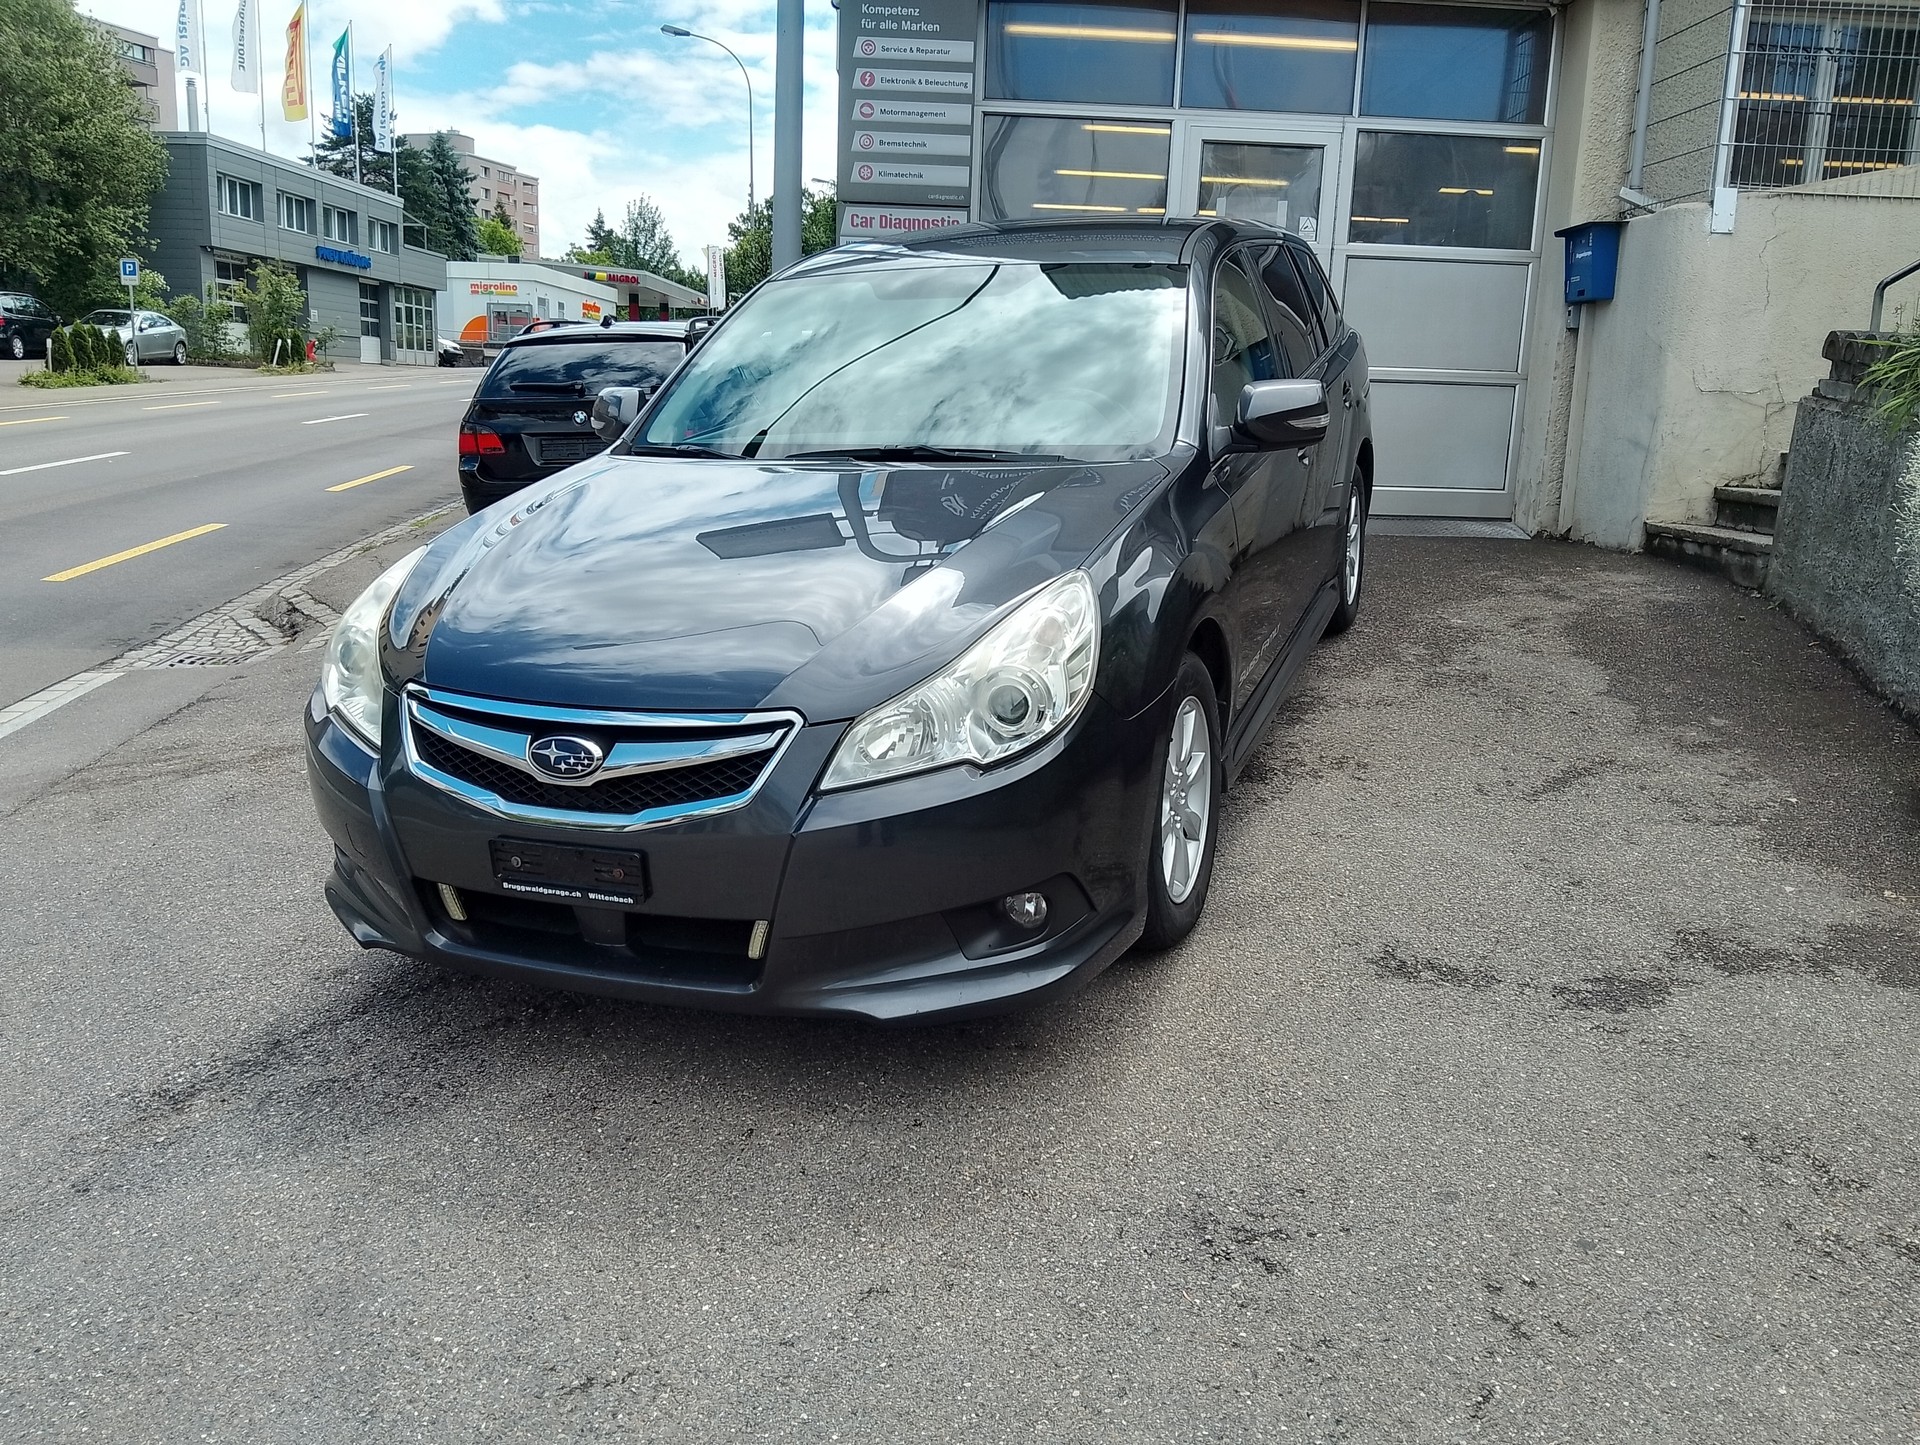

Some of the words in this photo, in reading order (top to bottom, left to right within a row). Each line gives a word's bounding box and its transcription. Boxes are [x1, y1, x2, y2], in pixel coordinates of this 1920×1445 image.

[861, 3, 920, 17] Kompetenz
[861, 18, 877, 29] für
[880, 19, 898, 30] alle
[901, 20, 940, 32] Marken
[179, 45, 190, 67] AG
[881, 45, 908, 54] Service
[909, 46, 915, 54] &
[916, 46, 951, 56] Reparatur
[880, 76, 917, 86] Elektronik
[917, 78, 923, 86] &
[924, 78, 969, 89] Beleuchtung
[879, 108, 947, 119] Motormanagement
[878, 139, 928, 149] Bremstechnik
[878, 170, 924, 180] Klimatechnik
[850, 213, 876, 228] Car
[125, 263, 134, 275] P
[607, 273, 641, 285] MIGROL
[470, 280, 518, 292] migrolino
[502, 882, 582, 898] Bruggwaldgarage.ch
[588, 892, 634, 904] Wittenbach
